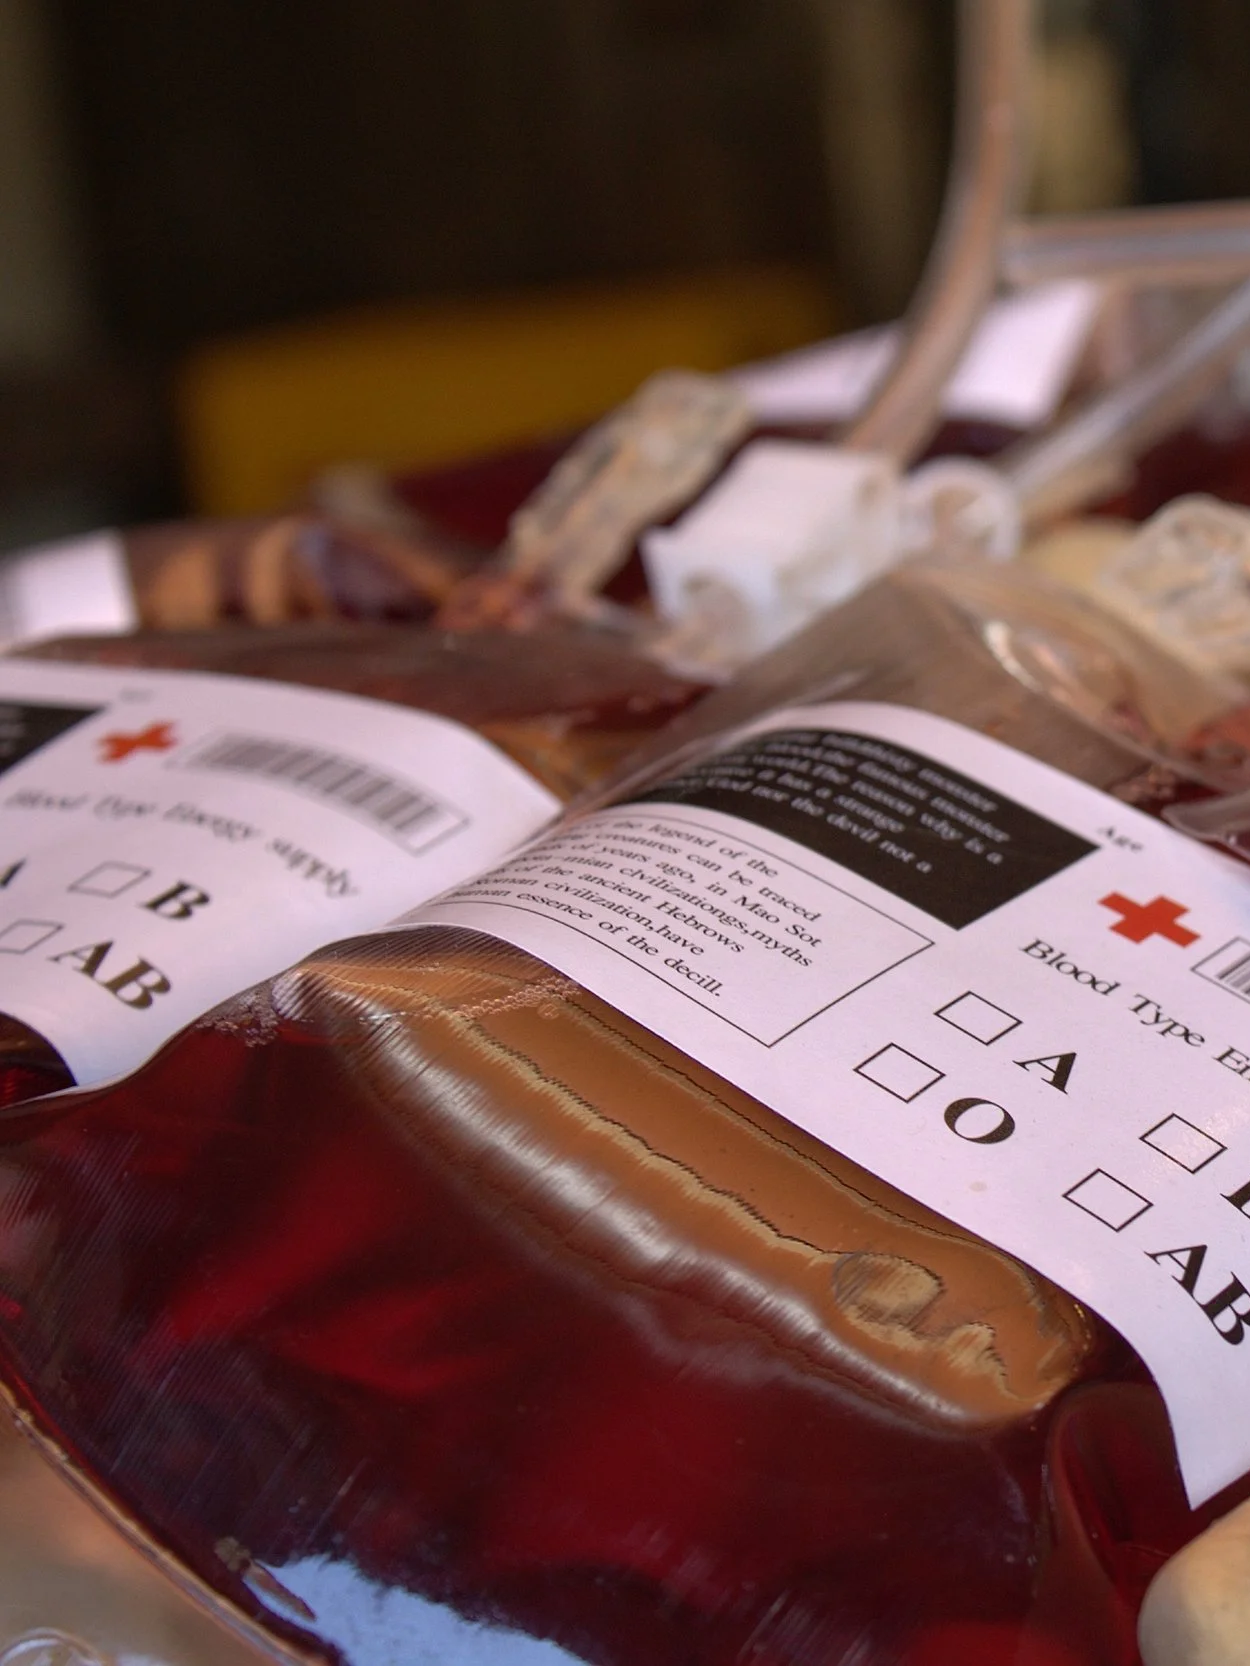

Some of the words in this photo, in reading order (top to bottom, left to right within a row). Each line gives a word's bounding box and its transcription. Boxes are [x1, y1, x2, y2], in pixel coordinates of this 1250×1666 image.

[649, 823, 717, 849] legend
[719, 844, 747, 860] of
[746, 858, 778, 878] the
[139, 880, 211, 919] B
[544, 882, 705, 956] civilization,have
[578, 871, 652, 904] ancient
[655, 900, 745, 954] Hebrows
[656, 861, 696, 884] ago,
[704, 882, 728, 897] in
[733, 895, 781, 925] Mao
[784, 923, 824, 949] Sot
[687, 853, 723, 873] can
[728, 870, 753, 887] be
[759, 886, 822, 923] traced
[46, 940, 171, 1011] AB
[516, 891, 594, 921] essence
[598, 920, 628, 935] of
[626, 935, 660, 957] the
[663, 957, 723, 997] decill.
[1018, 937, 1121, 998] Blood
[1128, 993, 1206, 1051] Type
[1014, 1050, 1078, 1095] A
[943, 1097, 1016, 1145] O
